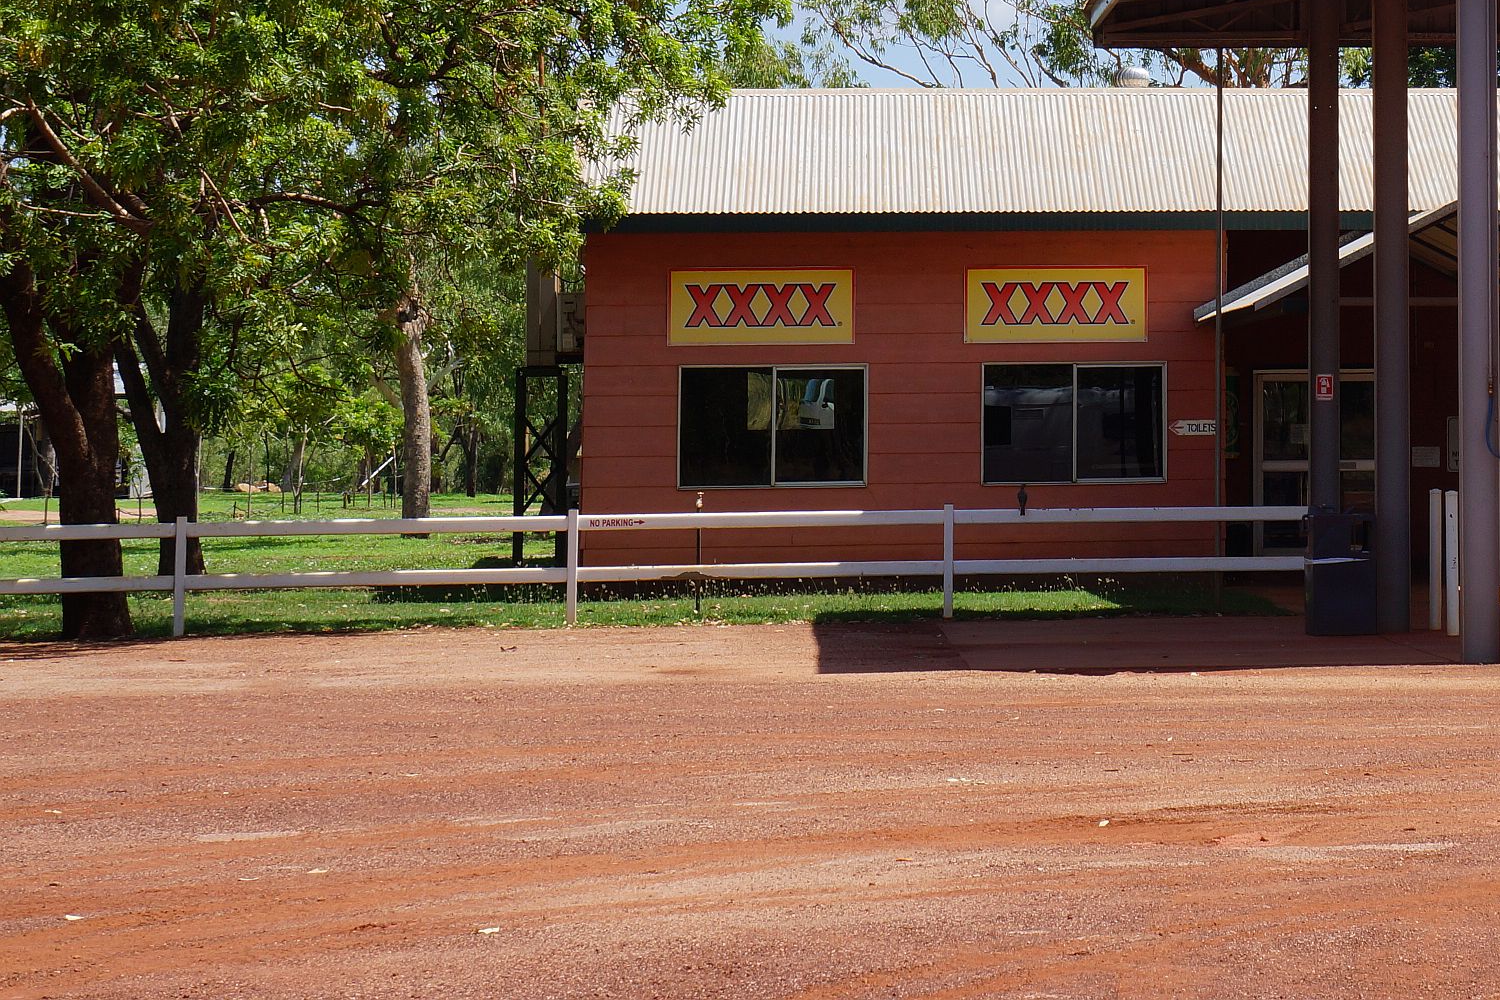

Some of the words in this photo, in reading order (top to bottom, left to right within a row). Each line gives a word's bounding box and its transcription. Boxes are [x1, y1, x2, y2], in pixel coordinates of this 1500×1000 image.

[684, 283, 837, 327] XXXX
[980, 282, 1129, 325] XXXX
[1187, 423, 1216, 432] TOILETS
[590, 519, 600, 527] NO
[602, 518, 633, 527] PARKING
